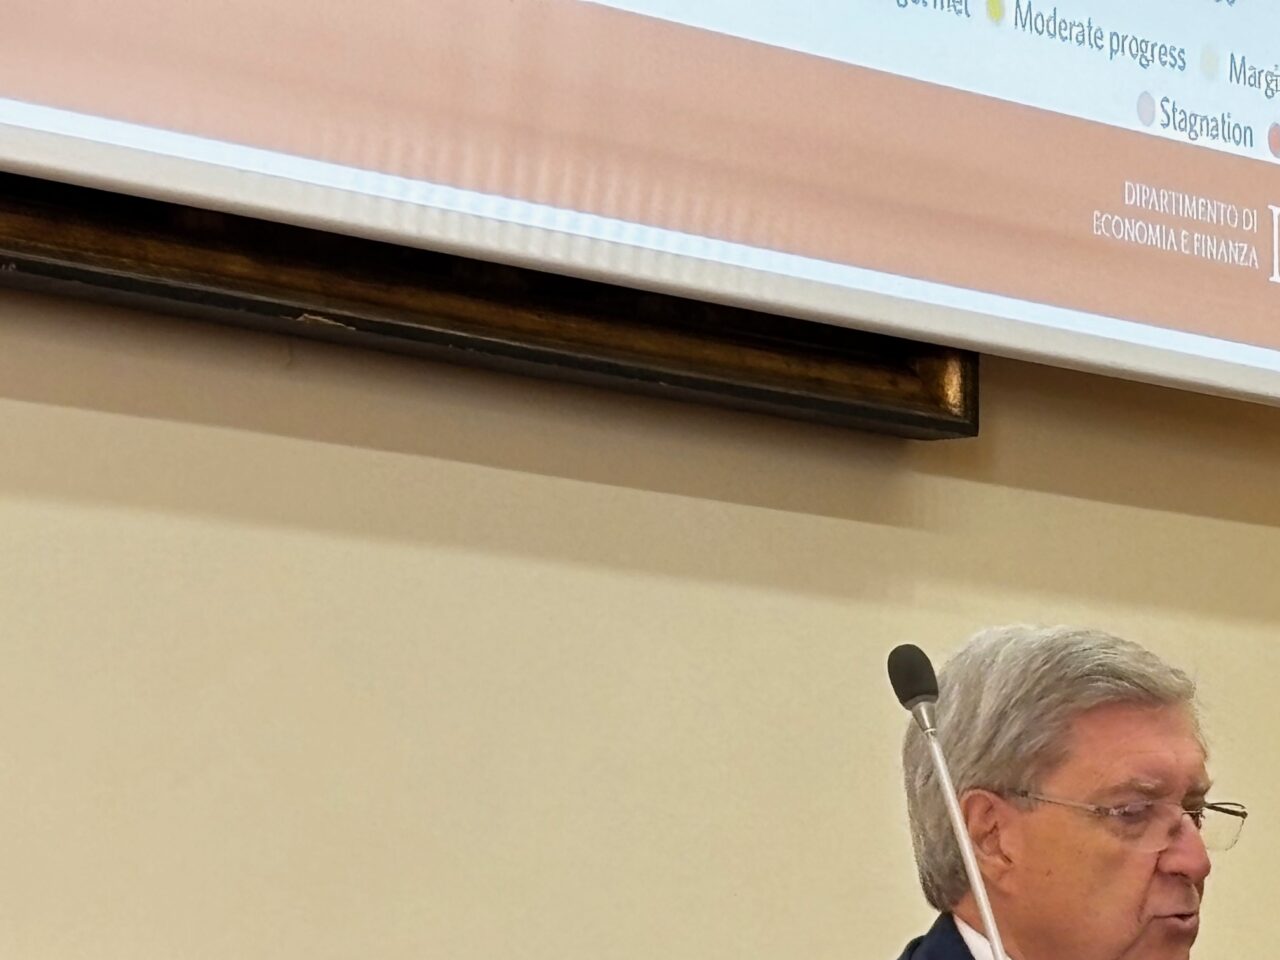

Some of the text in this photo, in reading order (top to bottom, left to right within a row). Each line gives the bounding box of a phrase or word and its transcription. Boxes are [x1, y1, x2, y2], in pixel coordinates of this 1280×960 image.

[1014, 0, 1104, 50] Moderate
[1108, 28, 1187, 72] progress
[1160, 96, 1254, 148] Stagnation
[1124, 181, 1258, 233] DIPARTIMENTO DI
[1093, 210, 1260, 269] ECONOMIA E FINANZA
